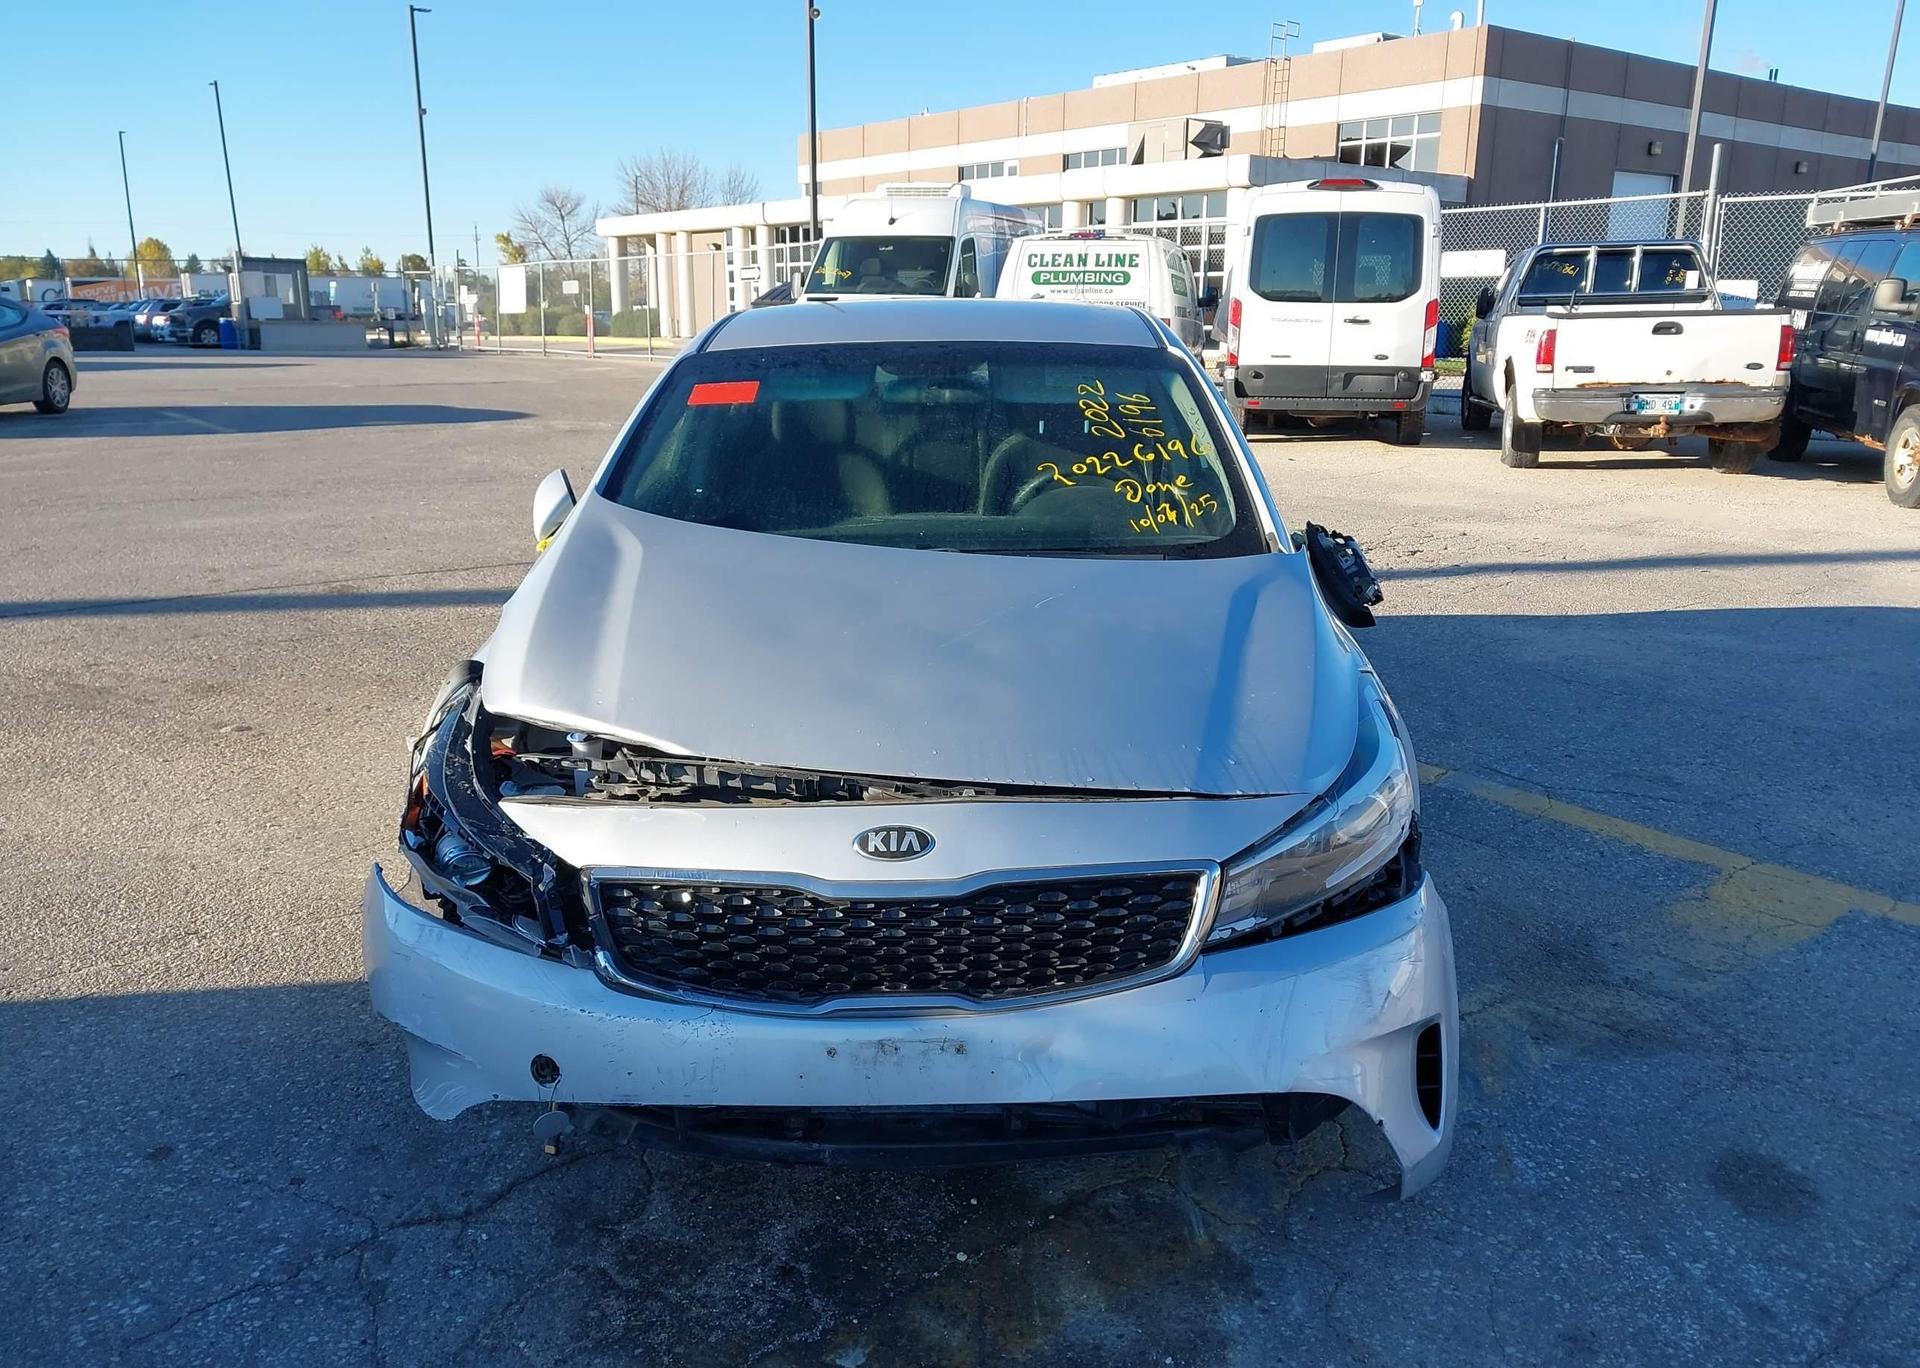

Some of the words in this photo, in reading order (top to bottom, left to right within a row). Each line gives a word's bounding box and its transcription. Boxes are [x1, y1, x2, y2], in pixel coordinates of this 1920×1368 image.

[1027, 253, 1089, 268] CLEAN
[1094, 253, 1140, 268] LINE
[1039, 272, 1124, 283] PLUMBING
[1077, 379, 1126, 439] 2022
[1114, 392, 1166, 438] 6196
[1114, 474, 1194, 503] Done
[867, 831, 921, 852] KIA
